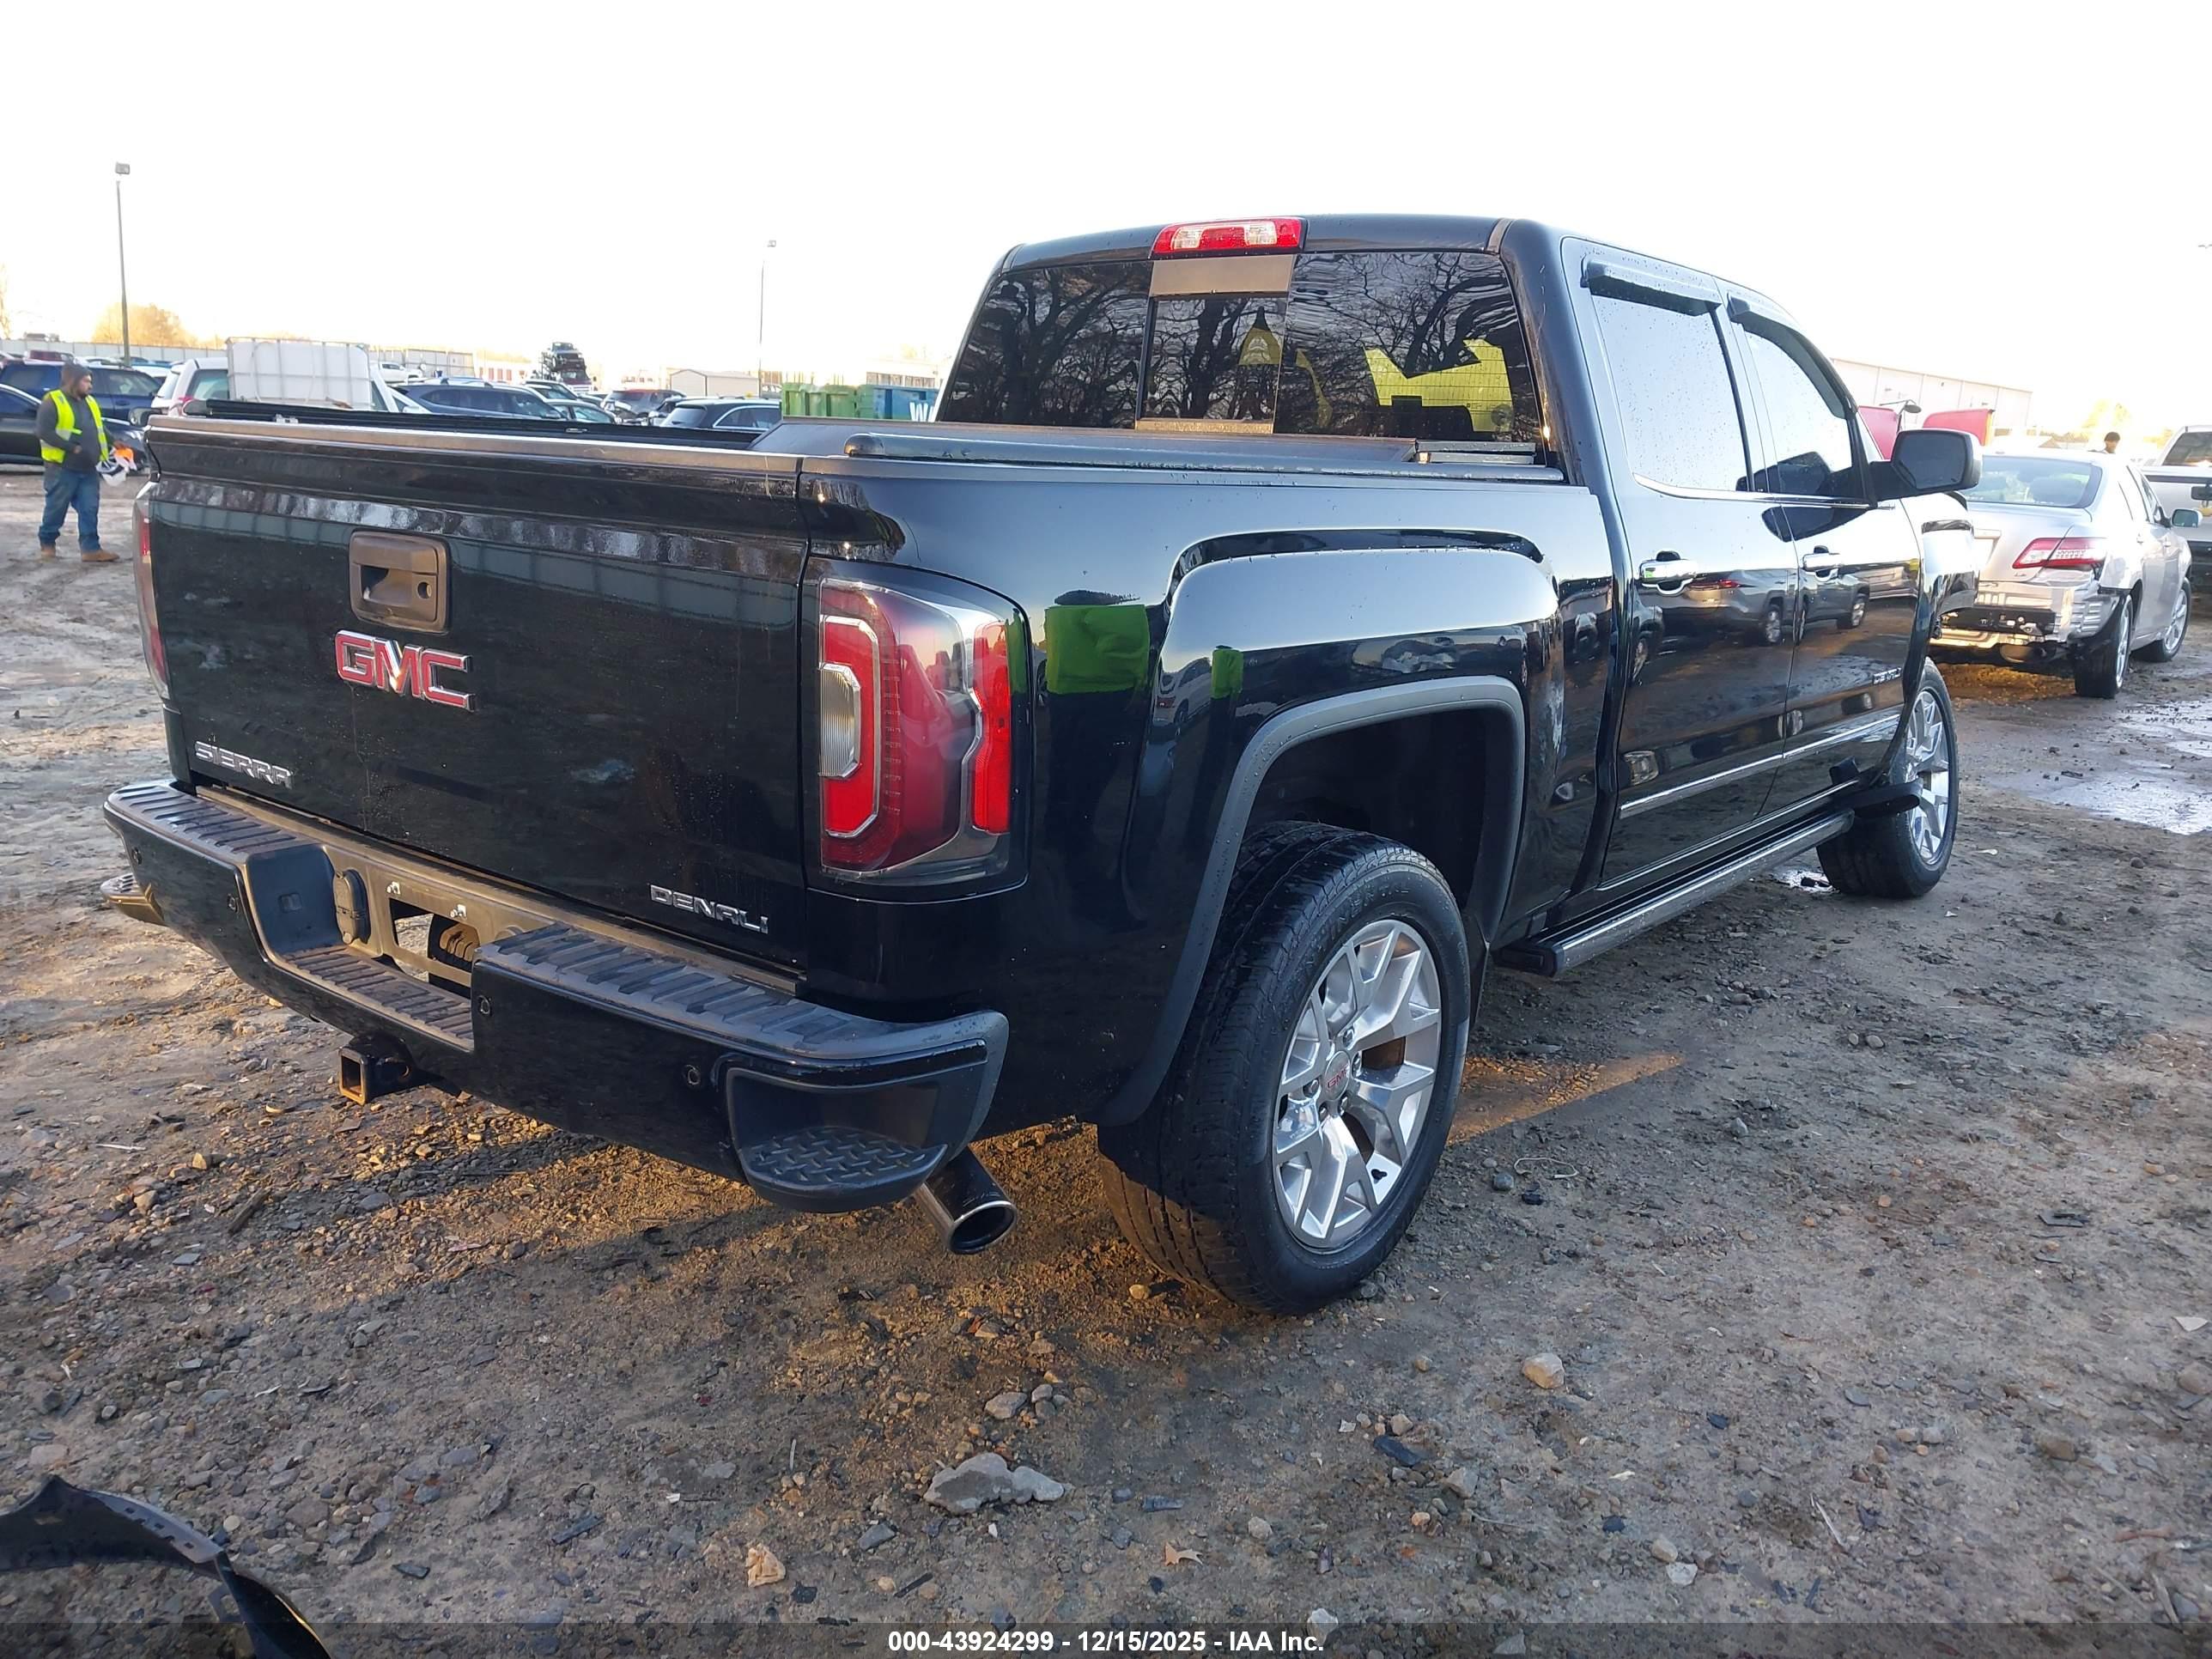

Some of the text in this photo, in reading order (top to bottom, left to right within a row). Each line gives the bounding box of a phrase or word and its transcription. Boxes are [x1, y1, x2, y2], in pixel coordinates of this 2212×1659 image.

[335, 629, 476, 712] GMC
[195, 741, 293, 789] SIERRA
[650, 884, 769, 934] DENALI
